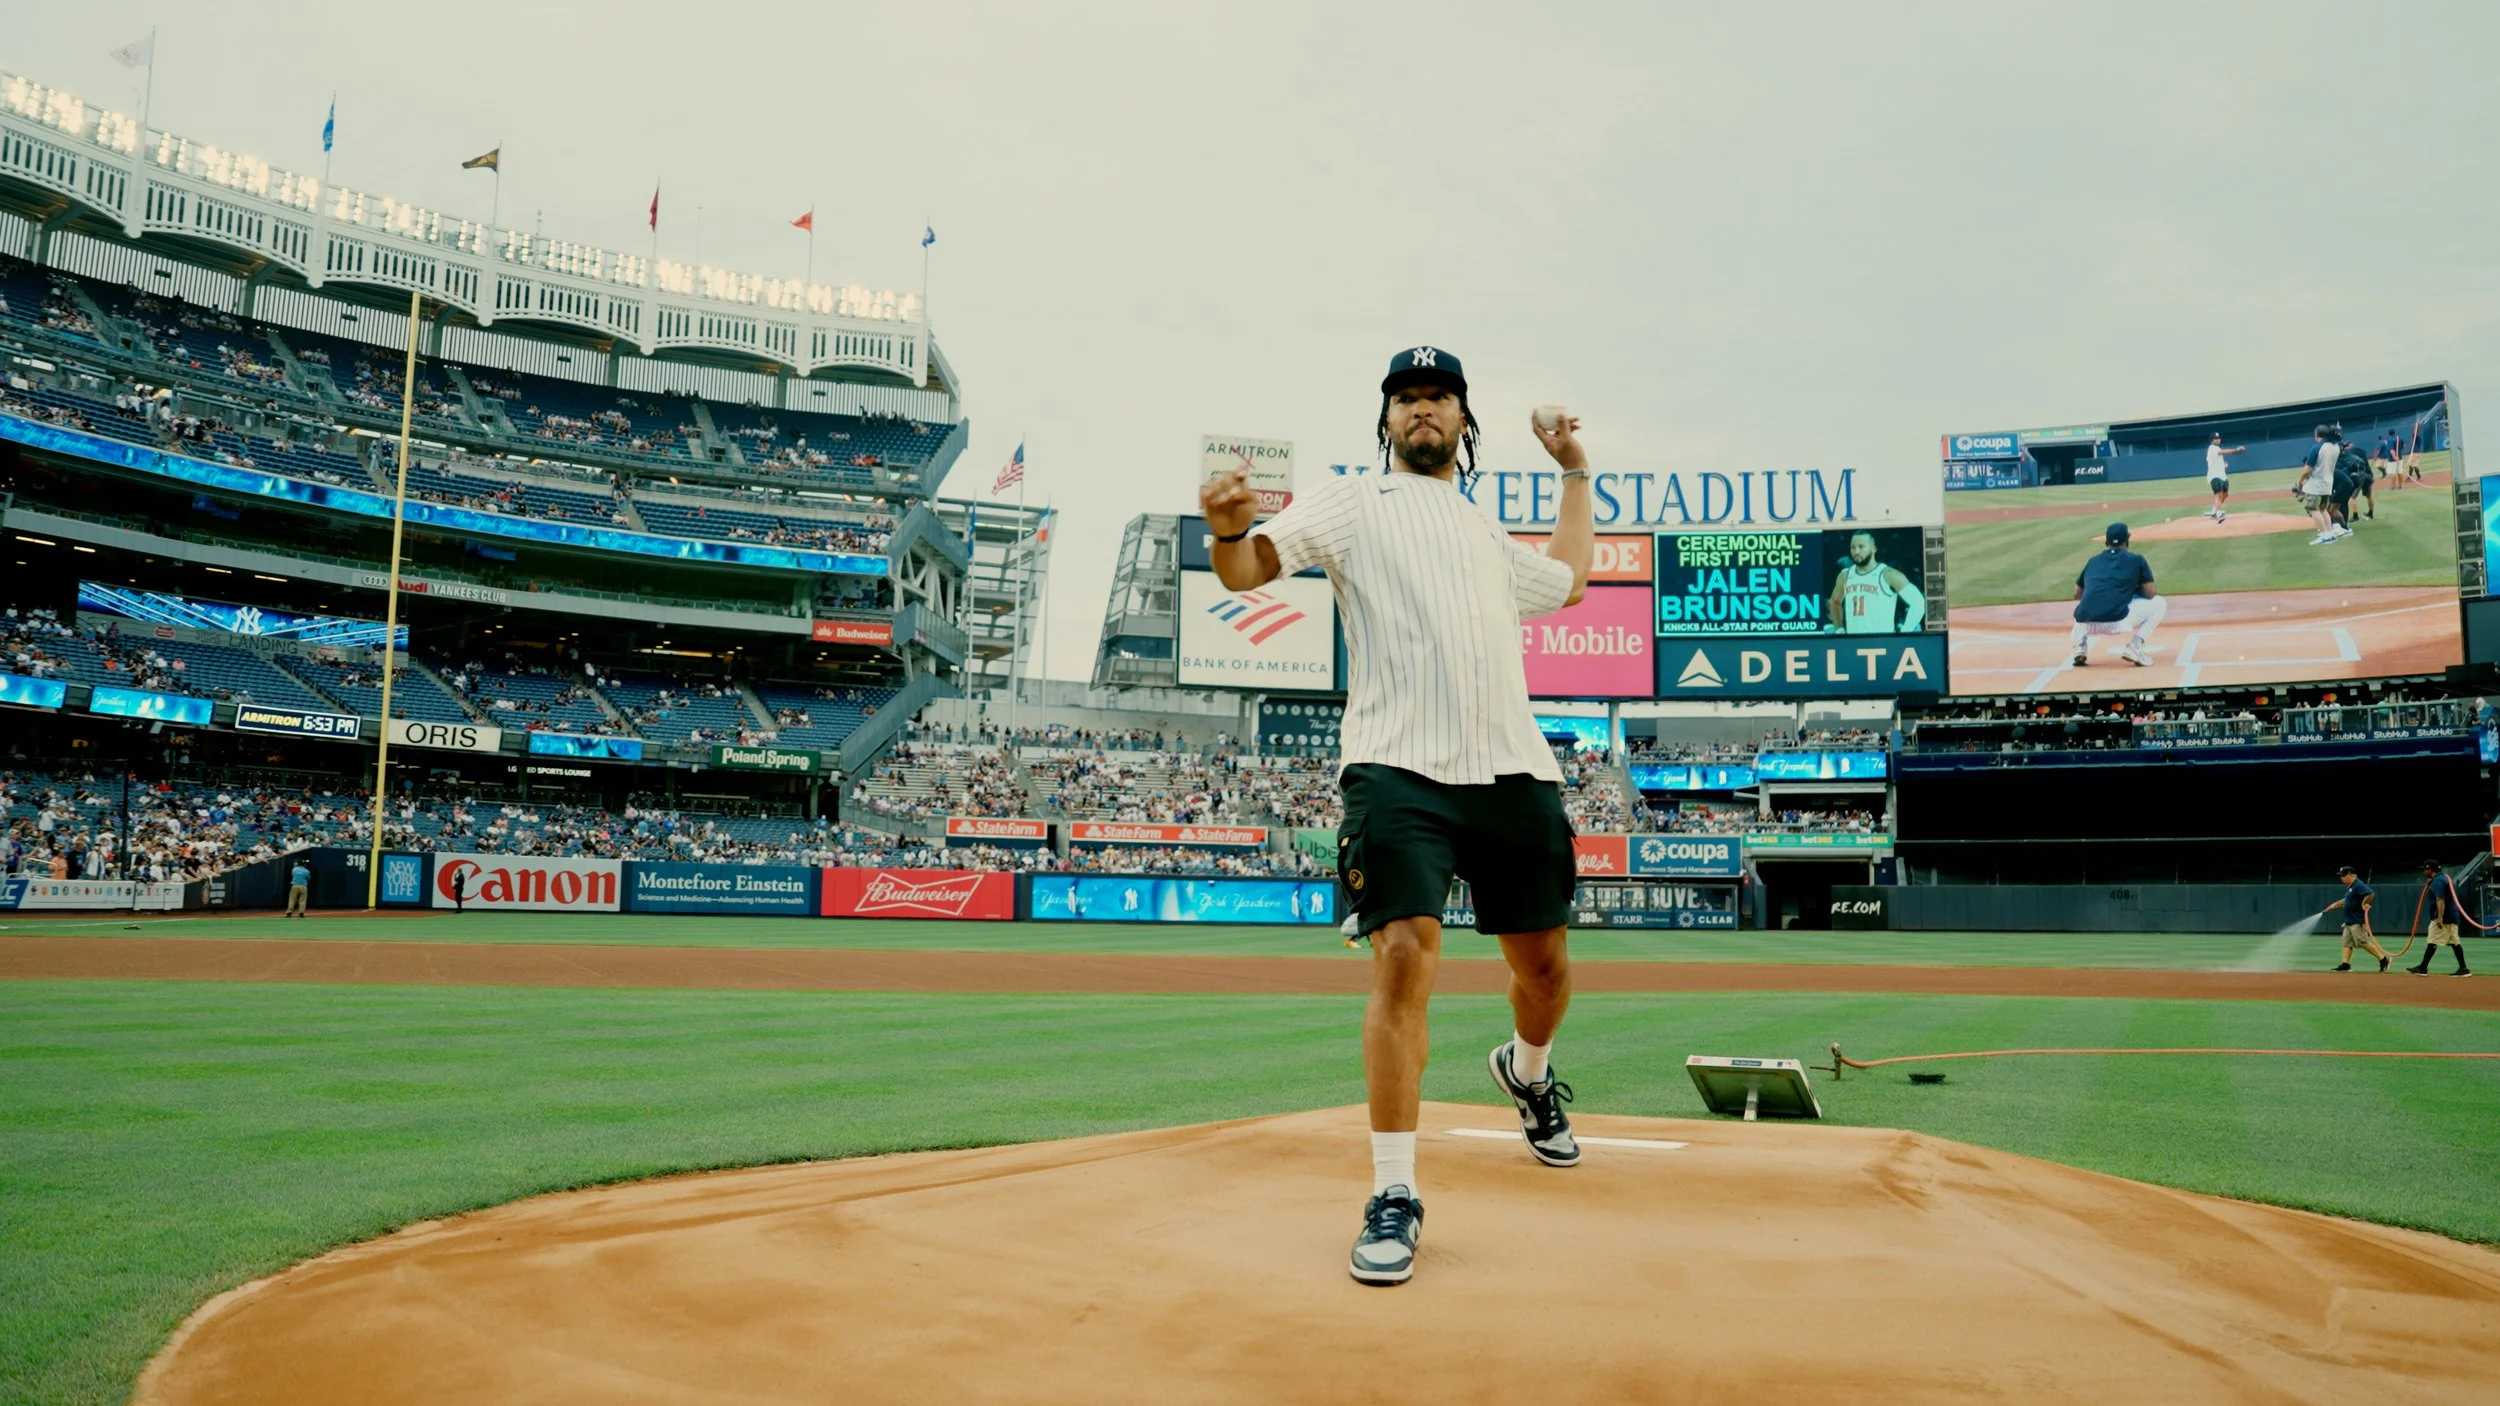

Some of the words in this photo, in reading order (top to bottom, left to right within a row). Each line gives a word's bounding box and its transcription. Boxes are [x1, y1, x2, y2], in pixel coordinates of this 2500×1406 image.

[1206, 442, 1289, 459] ARMITRON
[1973, 436, 2012, 450] coupa
[1593, 468, 1857, 525] STADIUM
[1677, 534, 1802, 551] CEREMONIAL
[1679, 551, 1734, 567] FIRST
[1738, 551, 1800, 566] PITCH:
[1688, 568, 1791, 594] JALEN
[398, 580, 428, 593] Audi
[433, 584, 479, 600] YANKEES
[480, 589, 507, 602] CLUB
[1661, 594, 1820, 621] BRUNSON
[1852, 595, 1865, 617] 11
[836, 628, 889, 641] Budweiser
[1664, 622, 1700, 632] KNICKS
[1701, 622, 1749, 632] ALL-STAR
[1750, 622, 1779, 632] POINT
[1781, 621, 1817, 631] GUARD
[228, 633, 299, 655] LANDING
[1540, 625, 1643, 656] Mobile
[1183, 657, 1226, 669] BANK
[1232, 660, 1251, 671] OF
[1256, 661, 1329, 674] AMERICA
[1740, 647, 1928, 684] DELTA
[241, 711, 302, 728] ARMITRON
[303, 715, 333, 733] 6:53
[336, 719, 355, 734] PM
[405, 722, 477, 748] ORIS
[2176, 738, 2209, 747] StubHub
[2212, 736, 2245, 745] StubHub
[2288, 734, 2323, 743] StubHub
[2373, 730, 2409, 739] StubHub
[2416, 728, 2453, 737] StubHub
[722, 747, 766, 765] Poland
[766, 749, 810, 771] Spring
[508, 765, 517, 773] LG
[537, 766, 563, 776] SPORTS
[564, 768, 591, 777] LOUNGE
[1801, 835, 1833, 844] bet365
[1856, 835, 1888, 844] bet365
[346, 854, 367, 867] 318
[1667, 843, 1729, 865] coupa
[388, 861, 415, 874] NEW
[1639, 866, 1666, 874] Business
[1668, 866, 1687, 875] Spend
[1688, 866, 1728, 875] Management
[386, 872, 417, 886] YORK
[437, 859, 616, 905] Canon
[637, 871, 731, 890] Montefiore
[735, 875, 804, 892] Einstein
[388, 884, 413, 897] LIFE
[867, 881, 971, 903] Budweiser
[637, 894, 665, 902] Science
[666, 894, 680, 902] and
[781, 897, 804, 905] Health
[1831, 900, 1882, 916] RE.COM
[1579, 912, 1597, 923] 399
[1612, 915, 1643, 924] STARR
[1697, 915, 1733, 925] CLEAR
